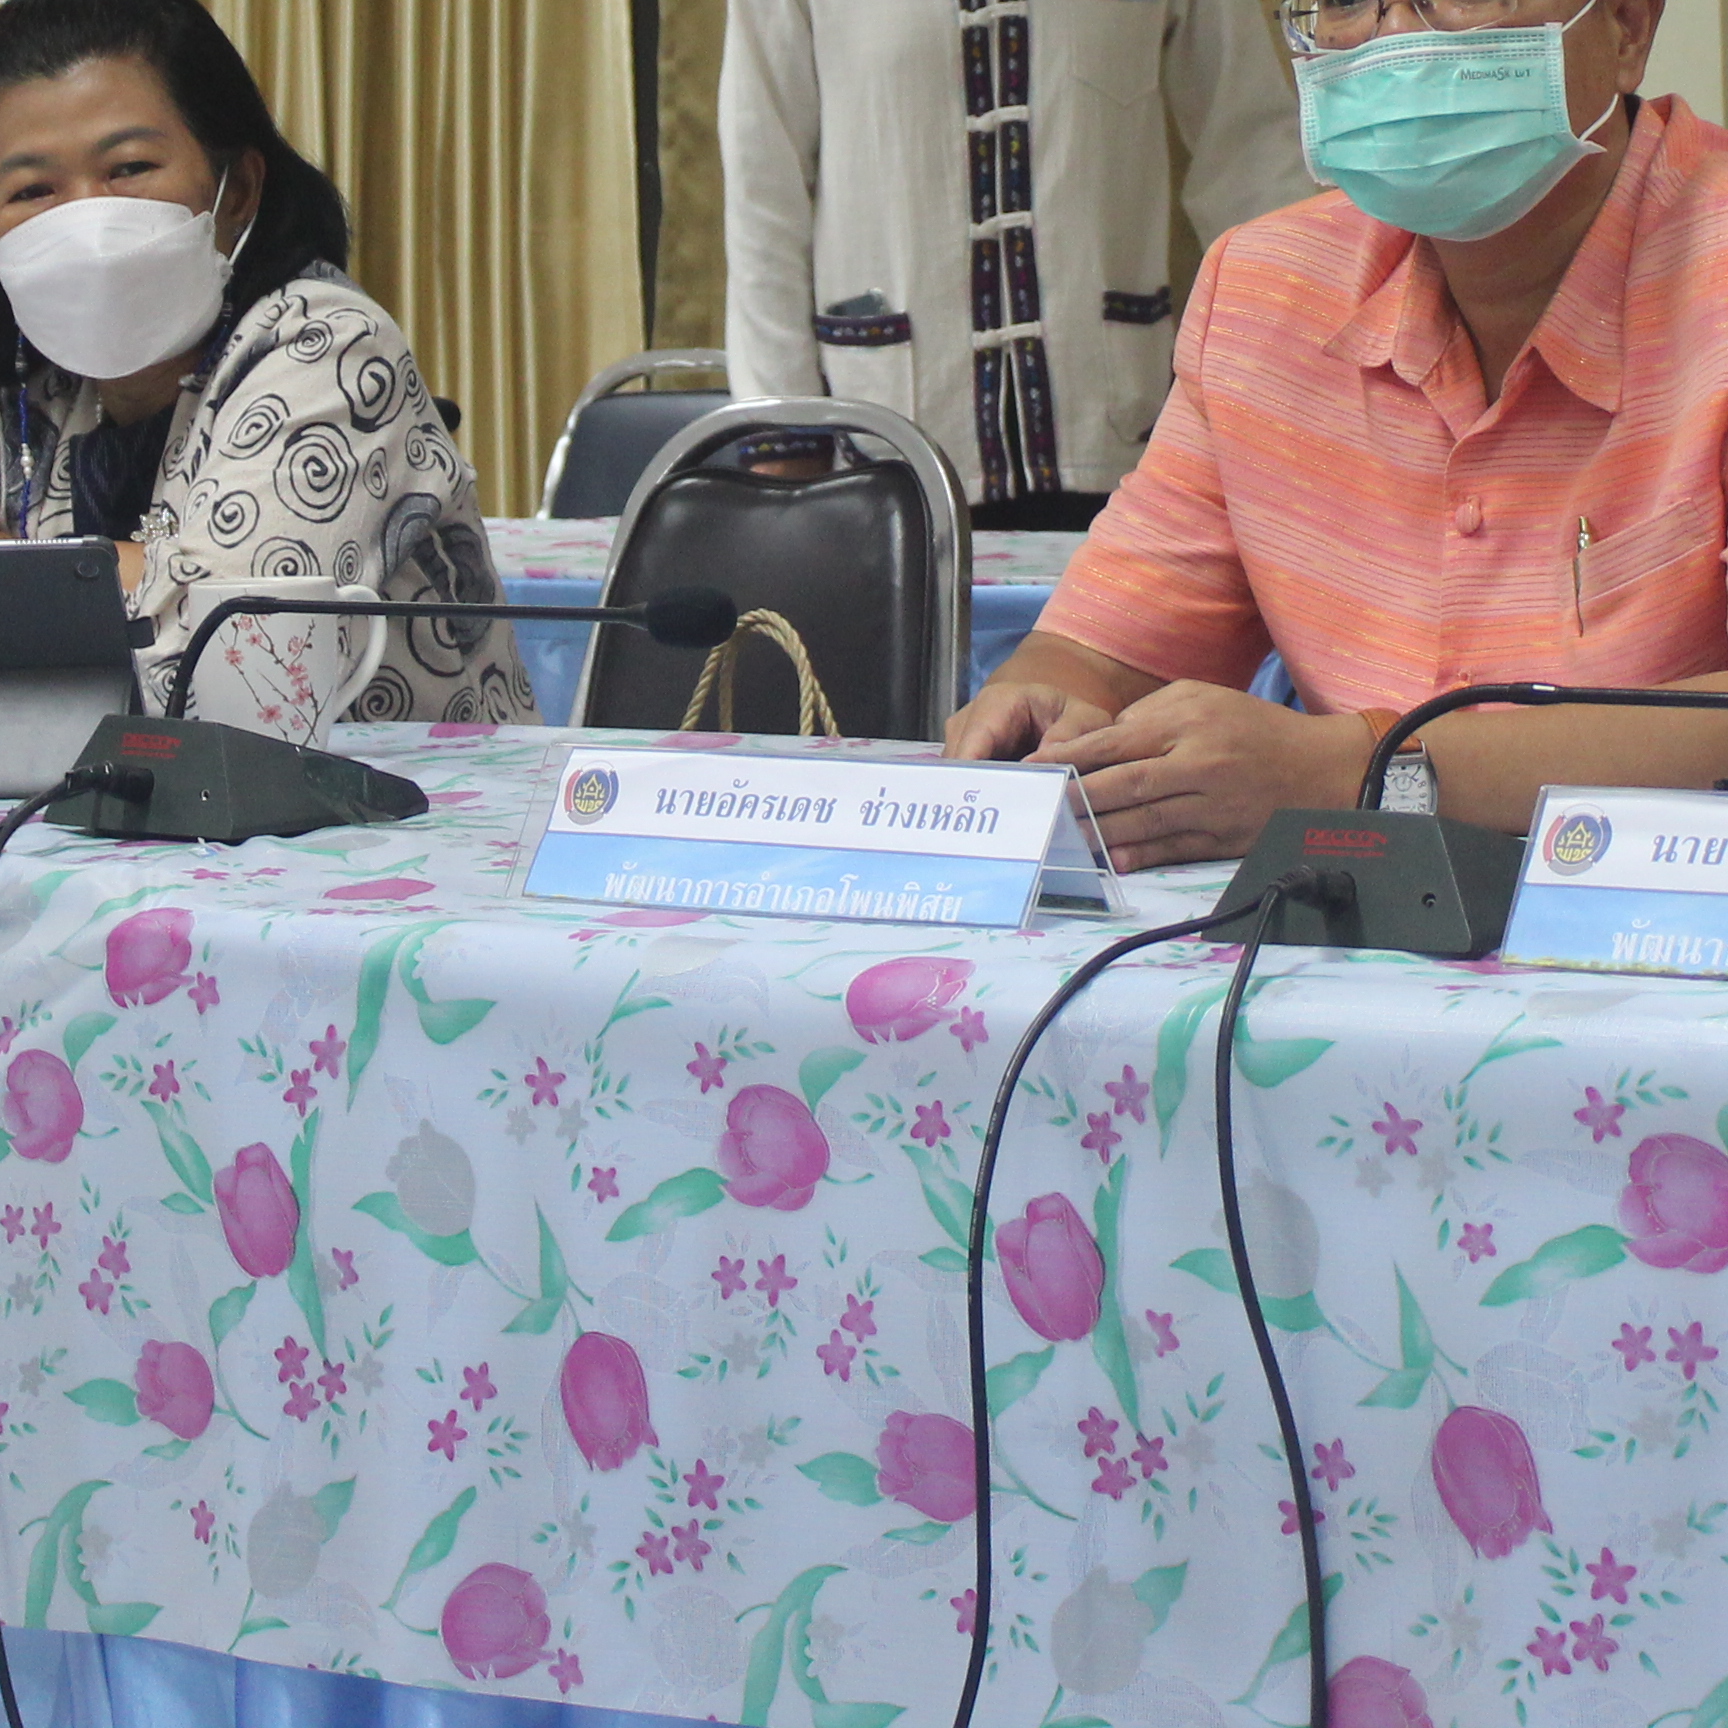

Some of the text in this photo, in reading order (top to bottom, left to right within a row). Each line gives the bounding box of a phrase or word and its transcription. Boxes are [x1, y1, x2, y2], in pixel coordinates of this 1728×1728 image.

[655, 778, 999, 834] นายอัครเดช ช่างเหล็ก
[604, 861, 963, 922] พัฒนาการอำเภอโพนพิสัย
